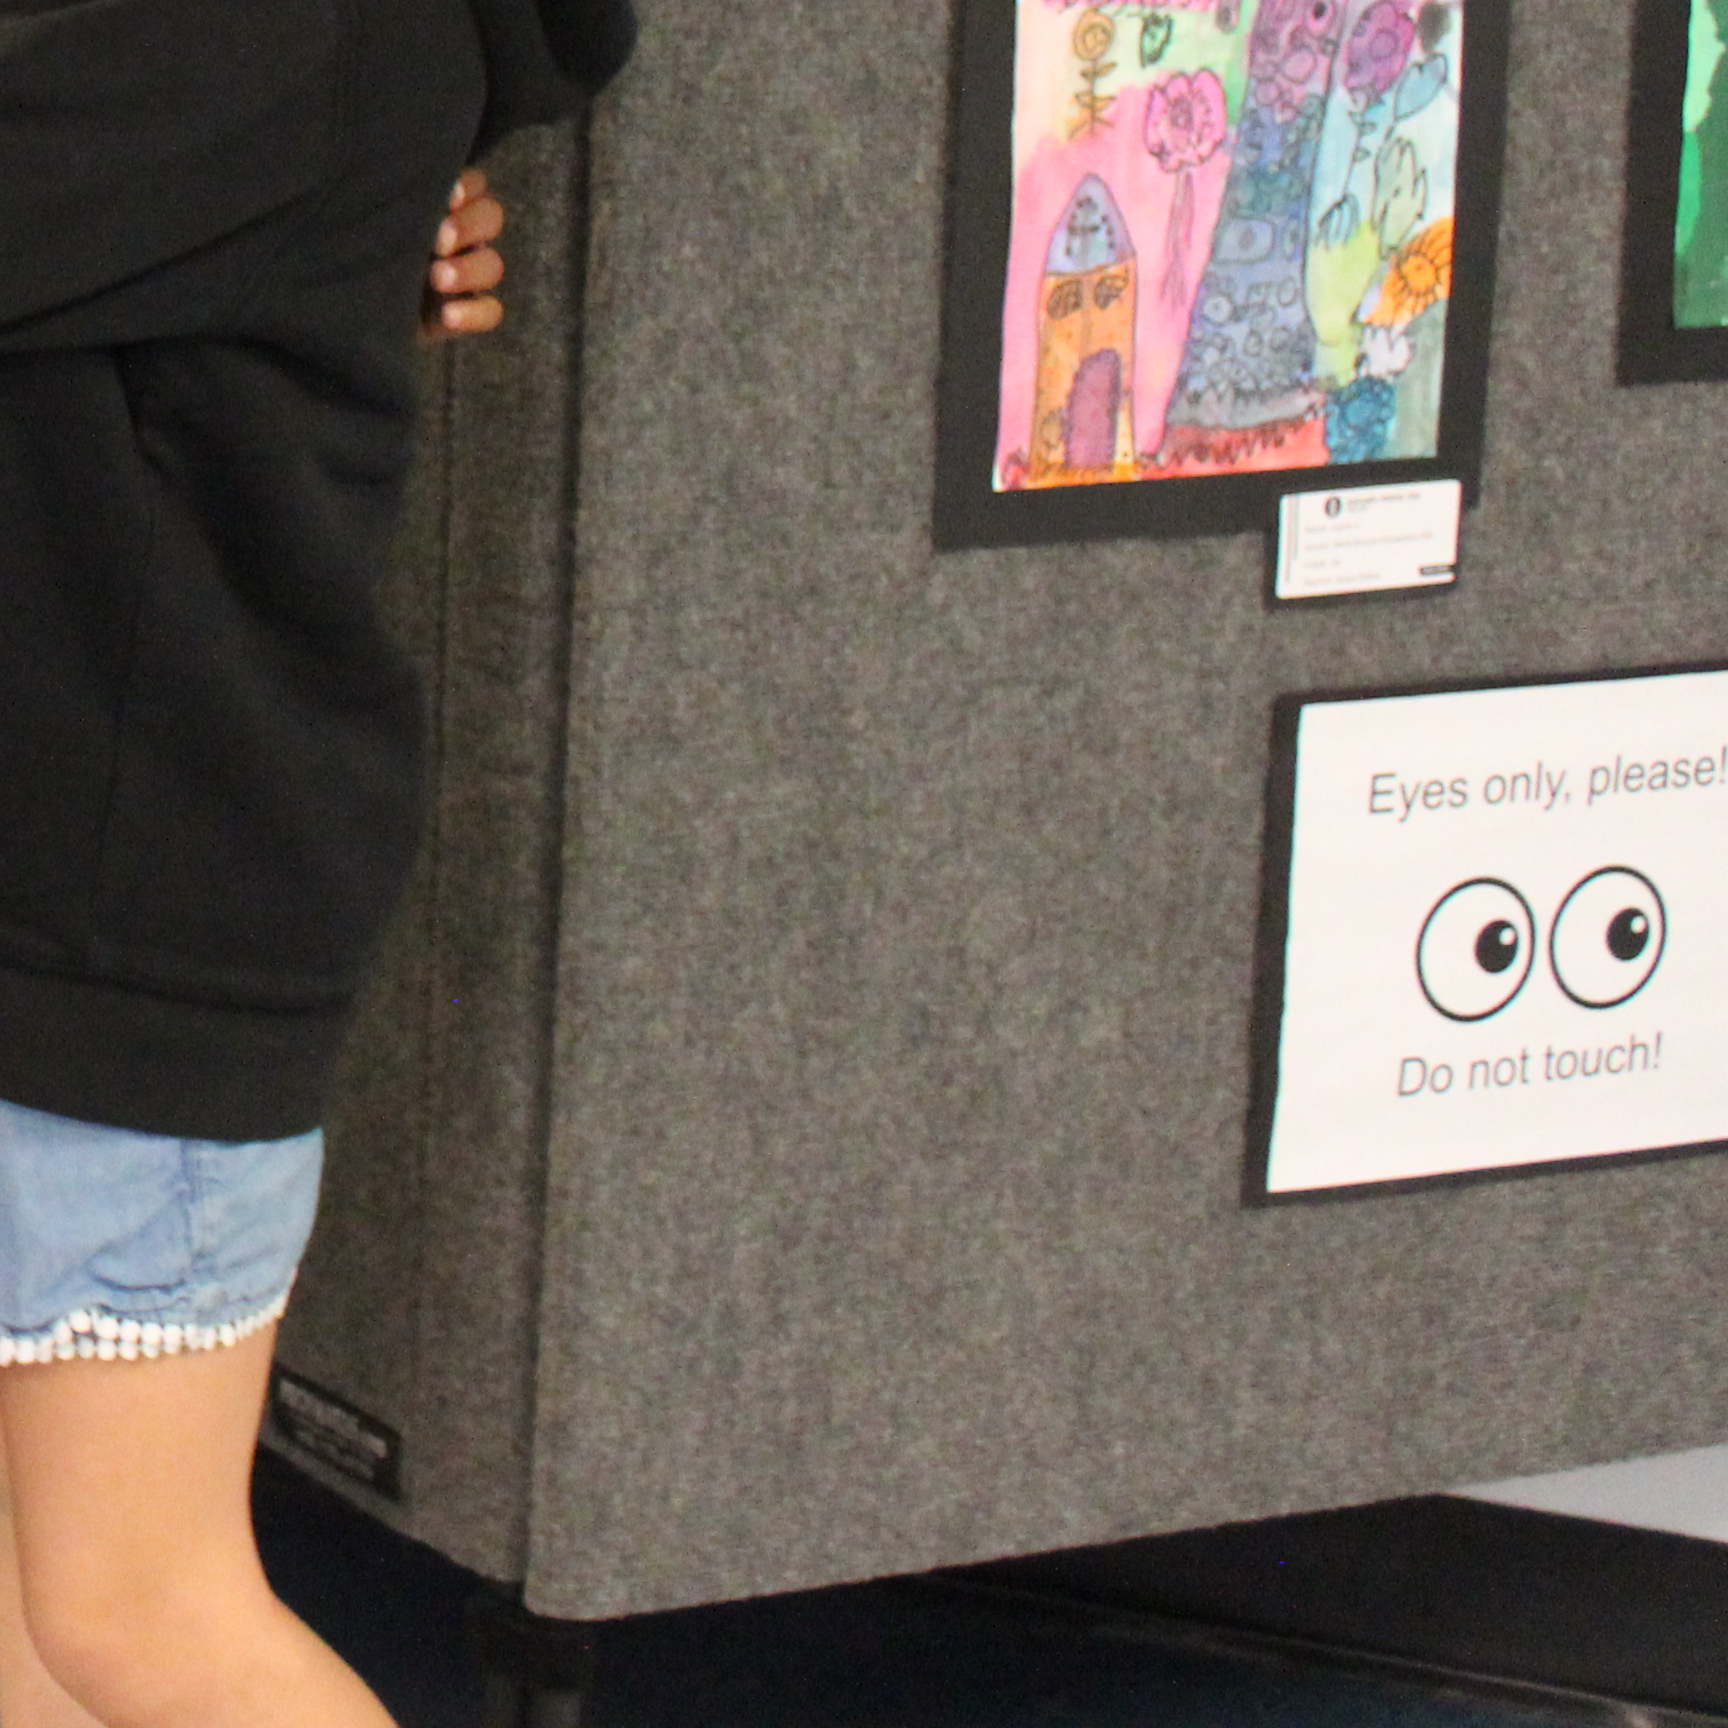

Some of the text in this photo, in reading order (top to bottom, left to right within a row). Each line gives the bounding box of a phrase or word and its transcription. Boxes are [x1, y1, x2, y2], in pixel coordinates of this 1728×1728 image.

[1368, 743, 1728, 822] Eyes only, please!
[1398, 1030, 1663, 1097] Do not touch!
